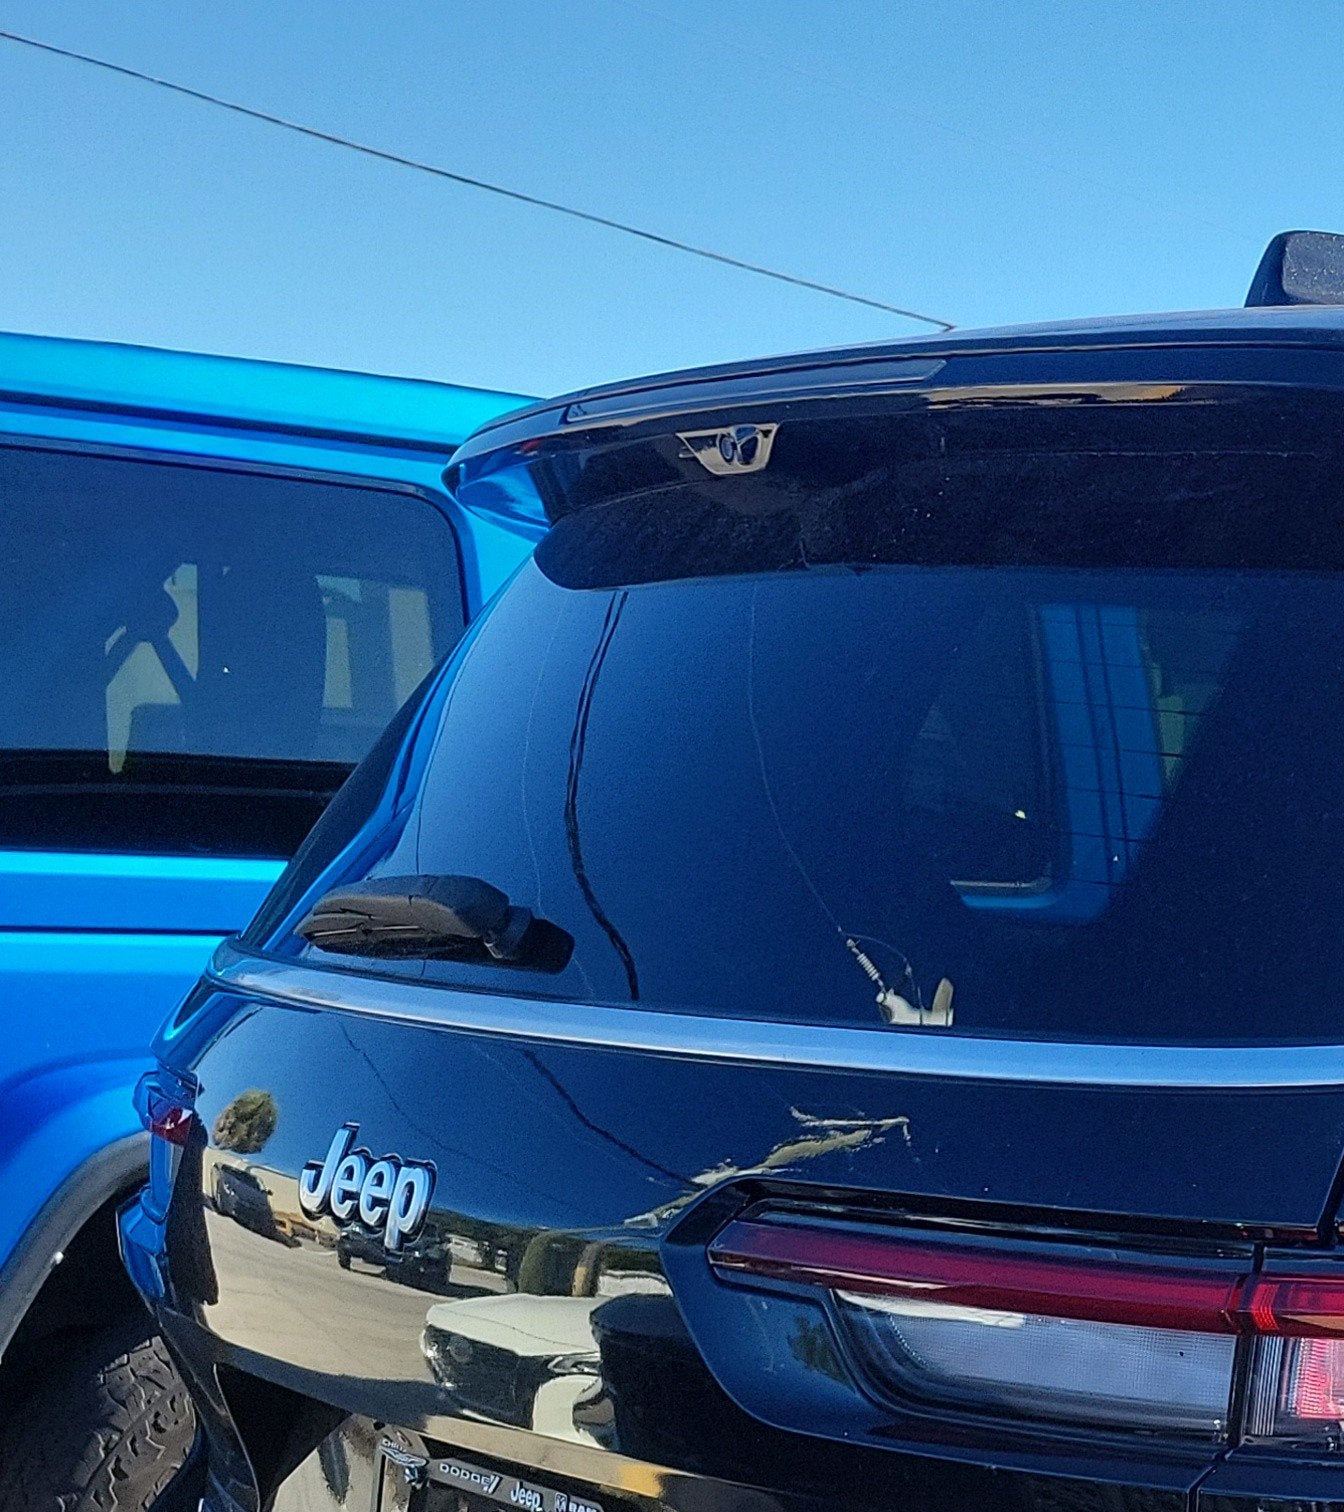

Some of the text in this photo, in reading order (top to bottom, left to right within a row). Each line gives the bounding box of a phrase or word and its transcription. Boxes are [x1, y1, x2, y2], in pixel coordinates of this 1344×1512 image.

[299, 1122, 437, 1251] Jeep
[439, 1462, 493, 1486] DODGE
[510, 1481, 541, 1510] Jeep
